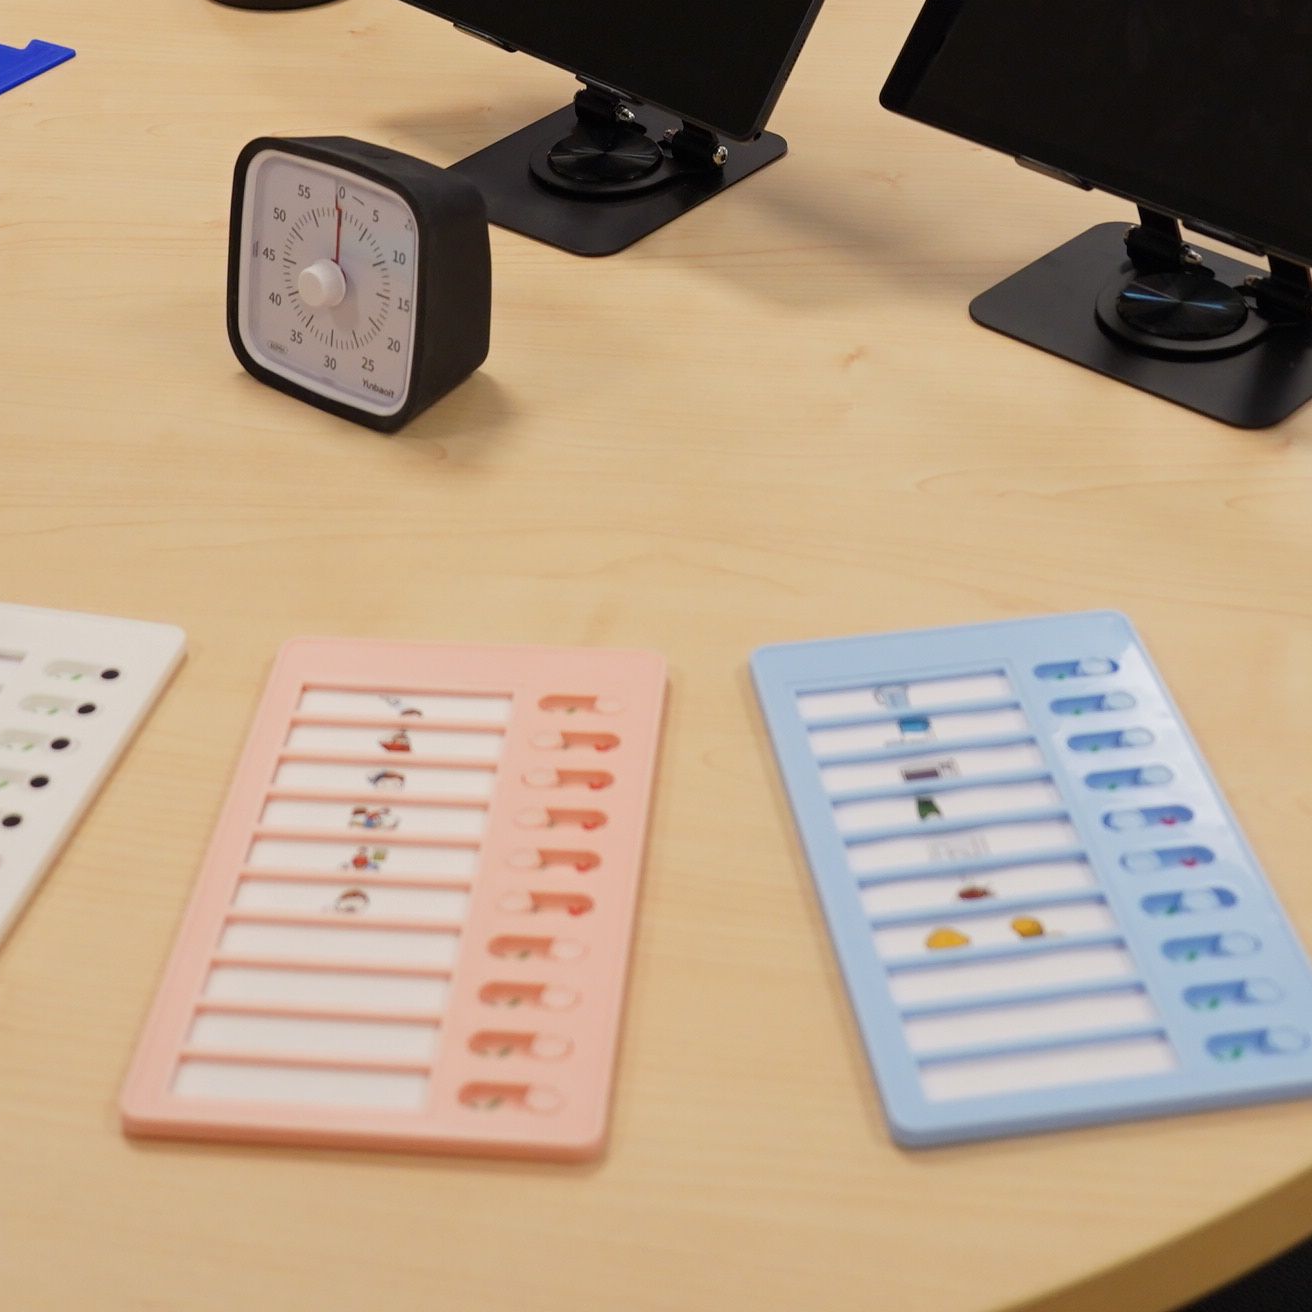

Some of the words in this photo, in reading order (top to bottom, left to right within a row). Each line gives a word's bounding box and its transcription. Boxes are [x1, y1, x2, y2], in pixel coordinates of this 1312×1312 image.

[297, 184, 311, 199] 55
[338, 186, 346, 199] 0
[273, 208, 286, 222] 50
[372, 210, 379, 223] 5
[262, 248, 276, 261] 45
[393, 250, 406, 264] 10
[269, 293, 282, 306] 40
[398, 298, 410, 313] 15
[290, 329, 303, 344] 35
[387, 337, 401, 353] 20
[323, 355, 337, 370] 30
[361, 357, 375, 372] 25
